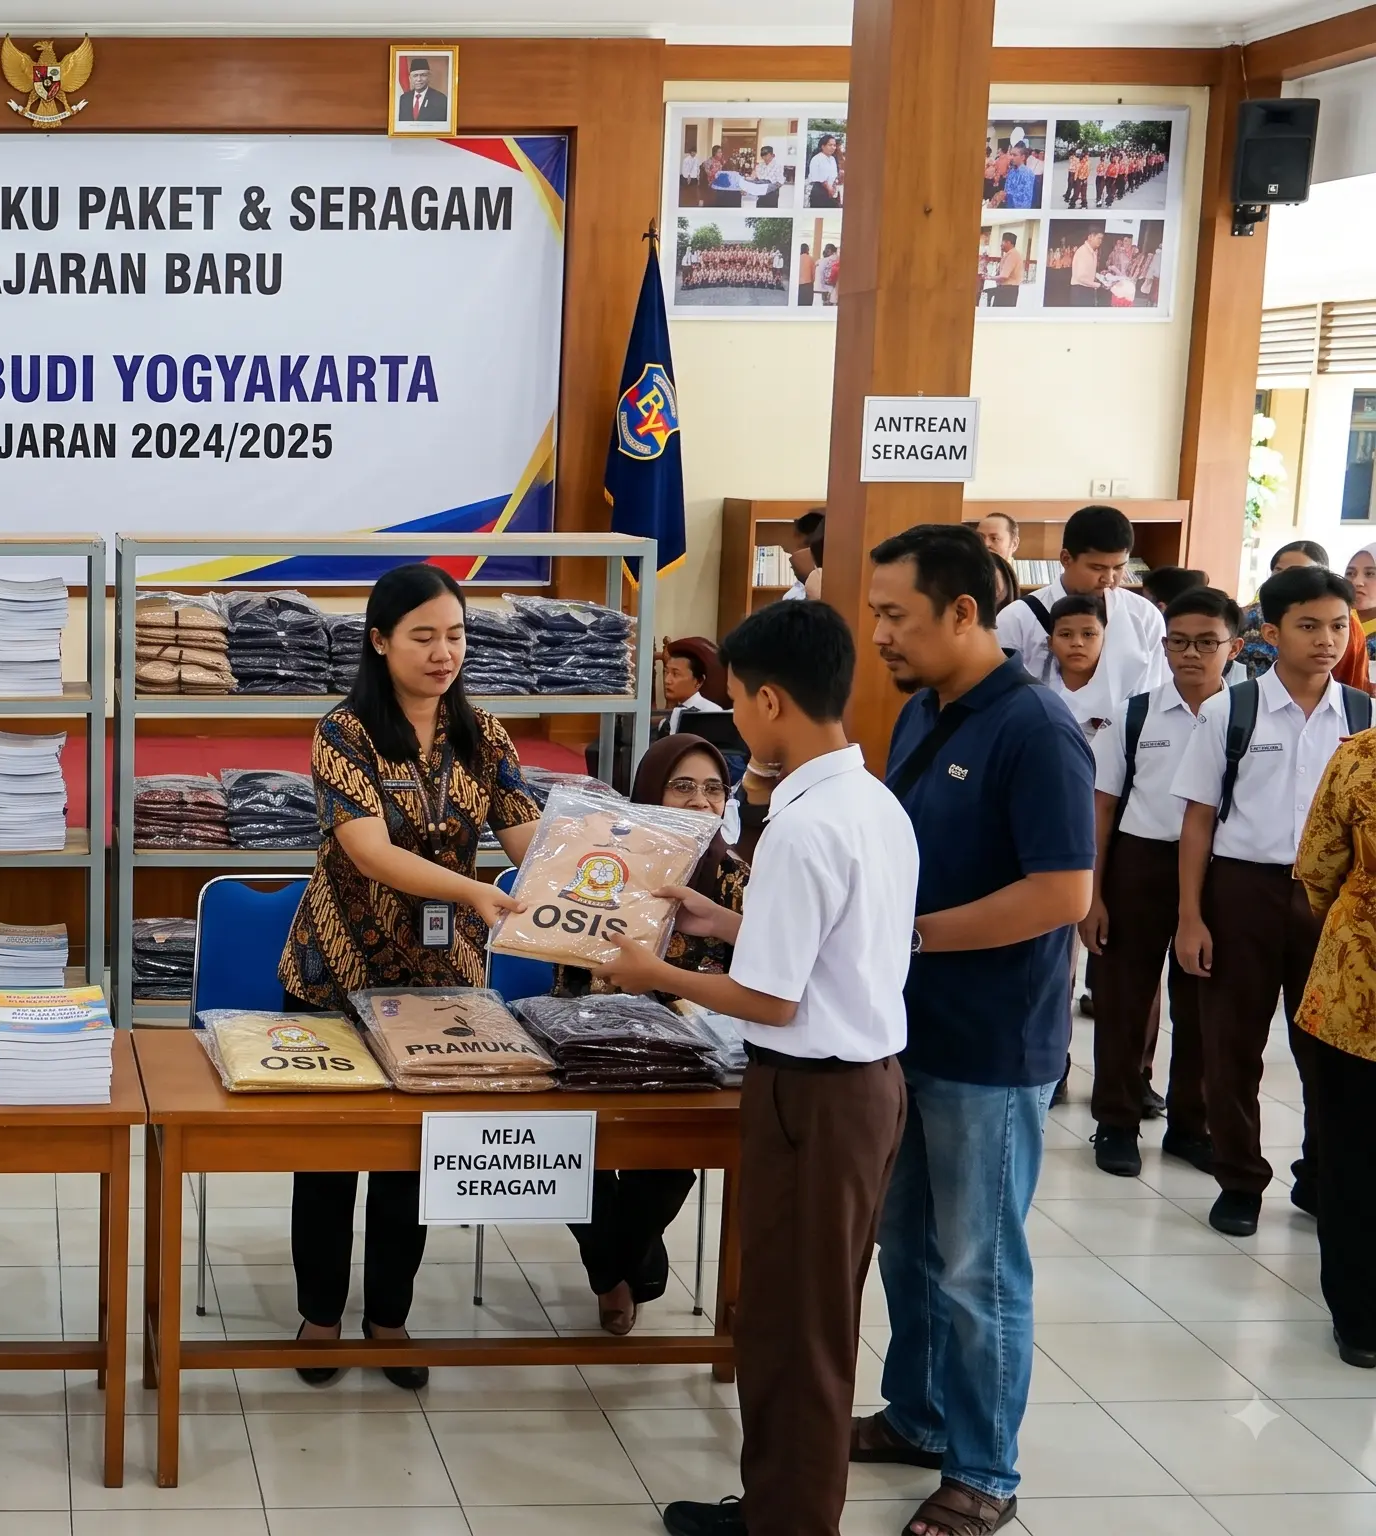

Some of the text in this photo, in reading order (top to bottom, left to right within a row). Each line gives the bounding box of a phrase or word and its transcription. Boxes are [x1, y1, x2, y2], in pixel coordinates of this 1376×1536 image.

[78, 186, 223, 231] PAKET
[239, 185, 272, 232] &
[289, 185, 513, 232] SERAGAM
[165, 252, 283, 296] BARU
[112, 353, 439, 403] YOGYAKARTA
[874, 416, 967, 433] ANTREAN
[131, 422, 333, 463] 2024/2025
[871, 444, 968, 461] SERAGAM
[532, 904, 628, 942] OSIS
[404, 1041, 540, 1057] PRAMUKA
[260, 1056, 356, 1072] OSIS
[482, 1128, 536, 1145] MEJA
[433, 1153, 582, 1171] PENGAMBILAN
[456, 1179, 556, 1196] SERAGAM
